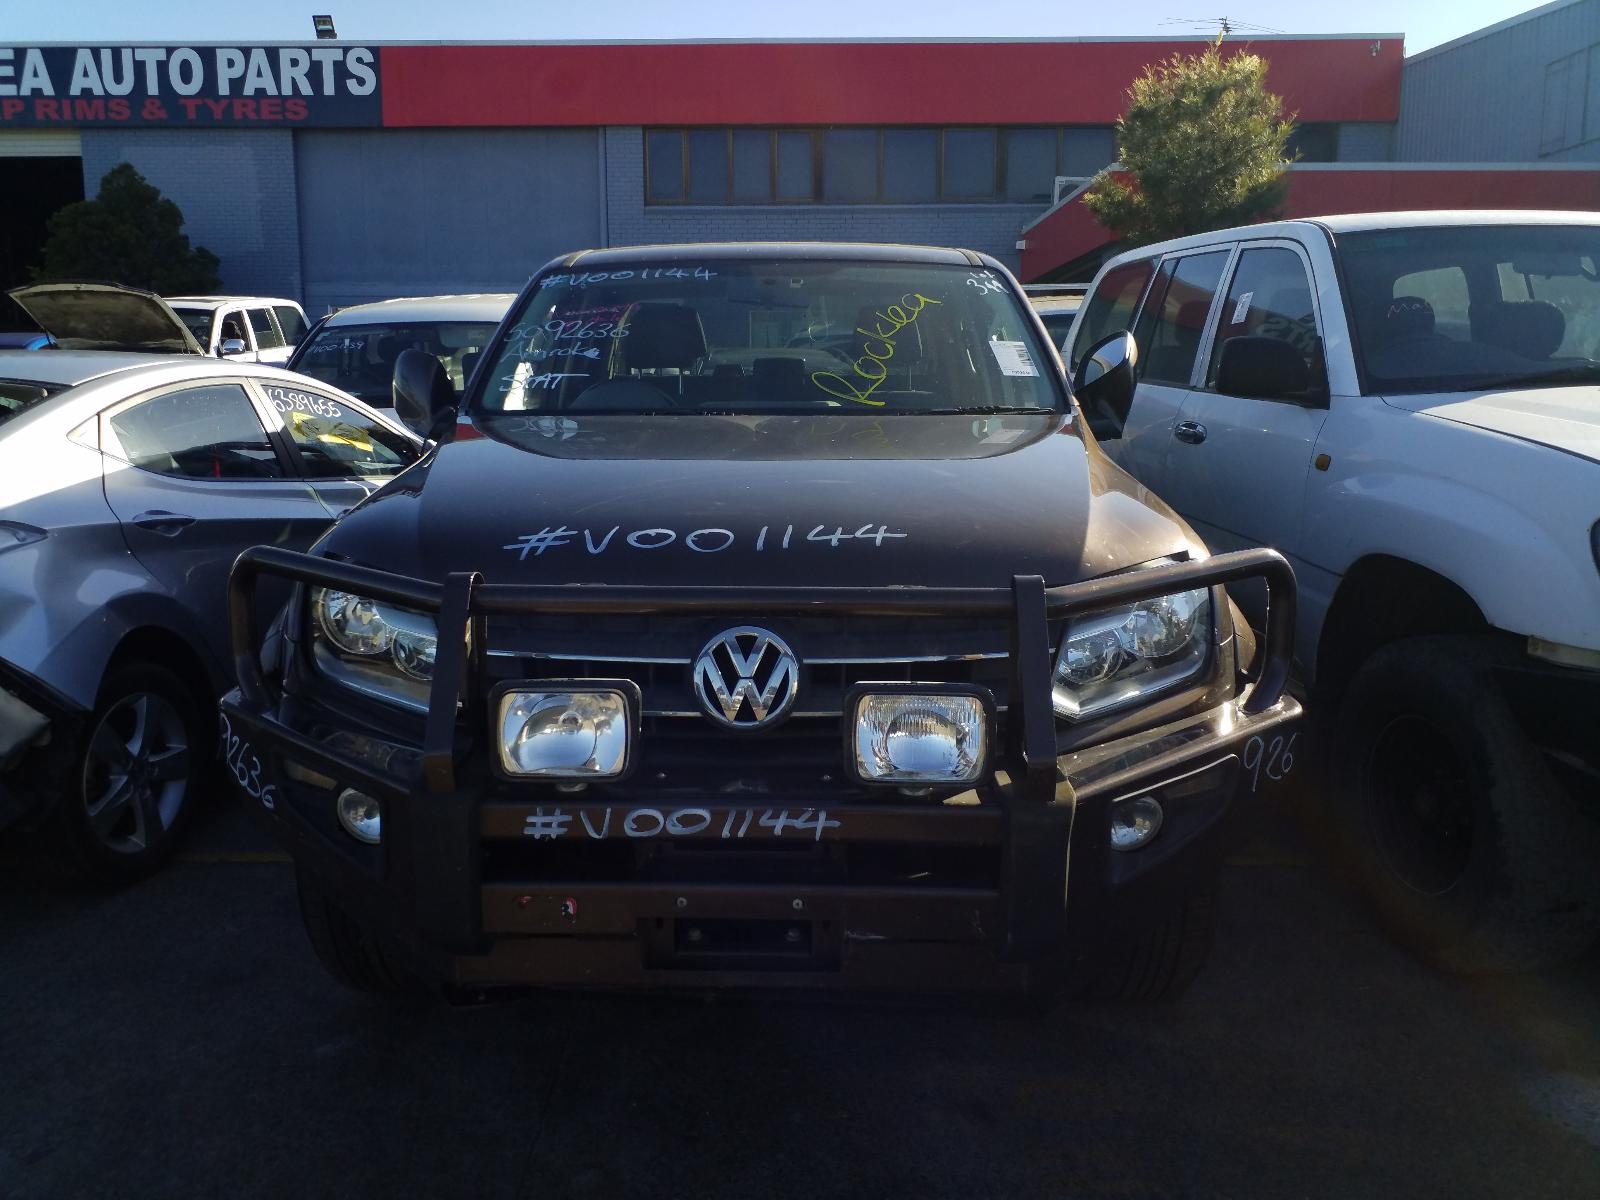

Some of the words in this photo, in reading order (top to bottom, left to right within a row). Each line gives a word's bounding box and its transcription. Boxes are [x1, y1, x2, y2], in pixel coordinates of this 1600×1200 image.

[69, 48, 204, 96] AUTO
[215, 48, 377, 96] PARTS
[35, 99, 131, 121] RIMS
[141, 99, 168, 121] &
[177, 99, 309, 121] TYRES
[811, 293, 943, 406] Rocklea
[267, 388, 342, 418] 6389655
[503, 524, 908, 560] #V001144
[1244, 731, 1297, 793] 926
[523, 807, 841, 841] #V001144
